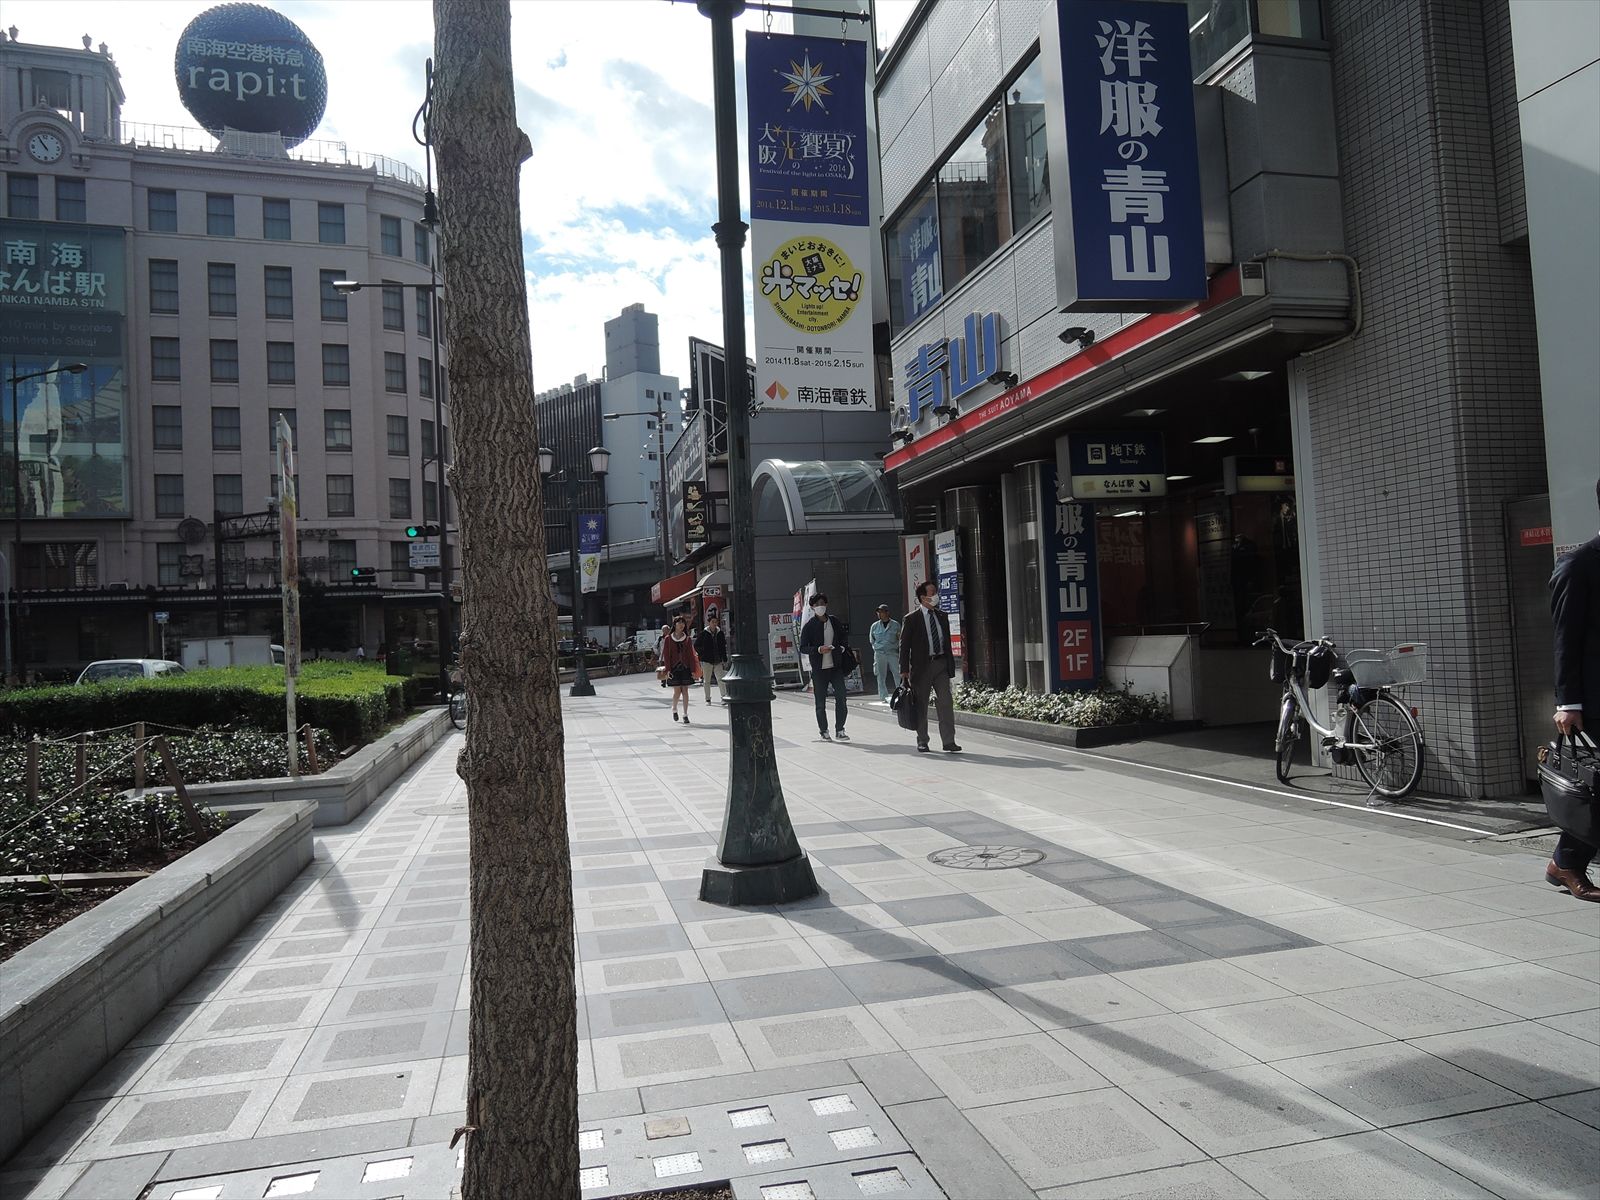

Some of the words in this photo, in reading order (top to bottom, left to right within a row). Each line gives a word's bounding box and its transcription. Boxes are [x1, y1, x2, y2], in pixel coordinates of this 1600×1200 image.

[186, 36, 305, 67] 南海空港特急
[1094, 20, 1171, 281] 洋服の青山
[829, 163, 846, 172] 2014
[4, 240, 83, 268] 南海
[911, 251, 942, 315] 青山
[34, 296, 78, 306] NAMBA
[81, 299, 104, 308] STN
[797, 346, 832, 355] 開催期間
[904, 311, 1003, 425] 青山
[798, 386, 868, 406] 南海電鉄
[999, 386, 1032, 411] AOYAMA
[1110, 443, 1147, 457] 地下鉄
[1103, 479, 1135, 489] なんば駅
[1063, 628, 1088, 647] 2F
[1066, 653, 1089, 672] 1F
